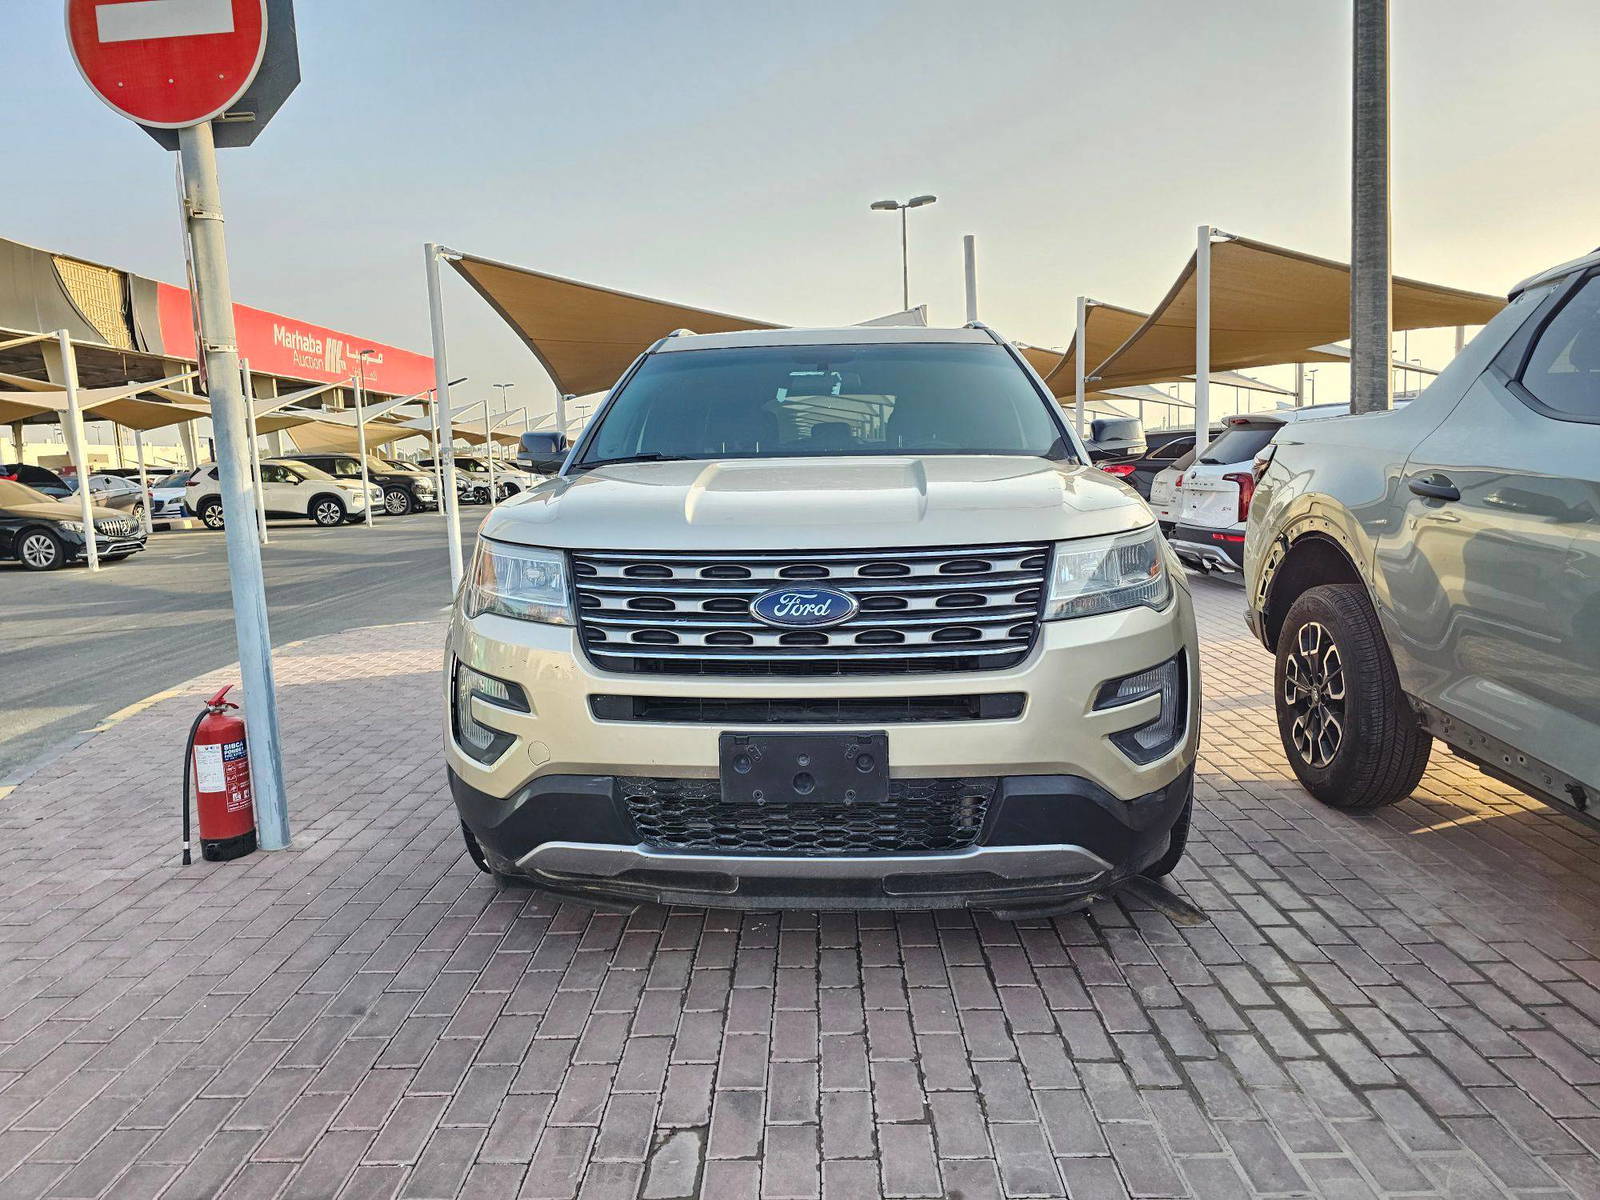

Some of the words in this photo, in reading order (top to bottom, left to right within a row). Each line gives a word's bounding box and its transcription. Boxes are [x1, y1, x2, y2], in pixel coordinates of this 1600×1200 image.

[273, 323, 323, 355] Marhaba
[293, 350, 325, 371] Auction
[773, 593, 832, 616] Ford
